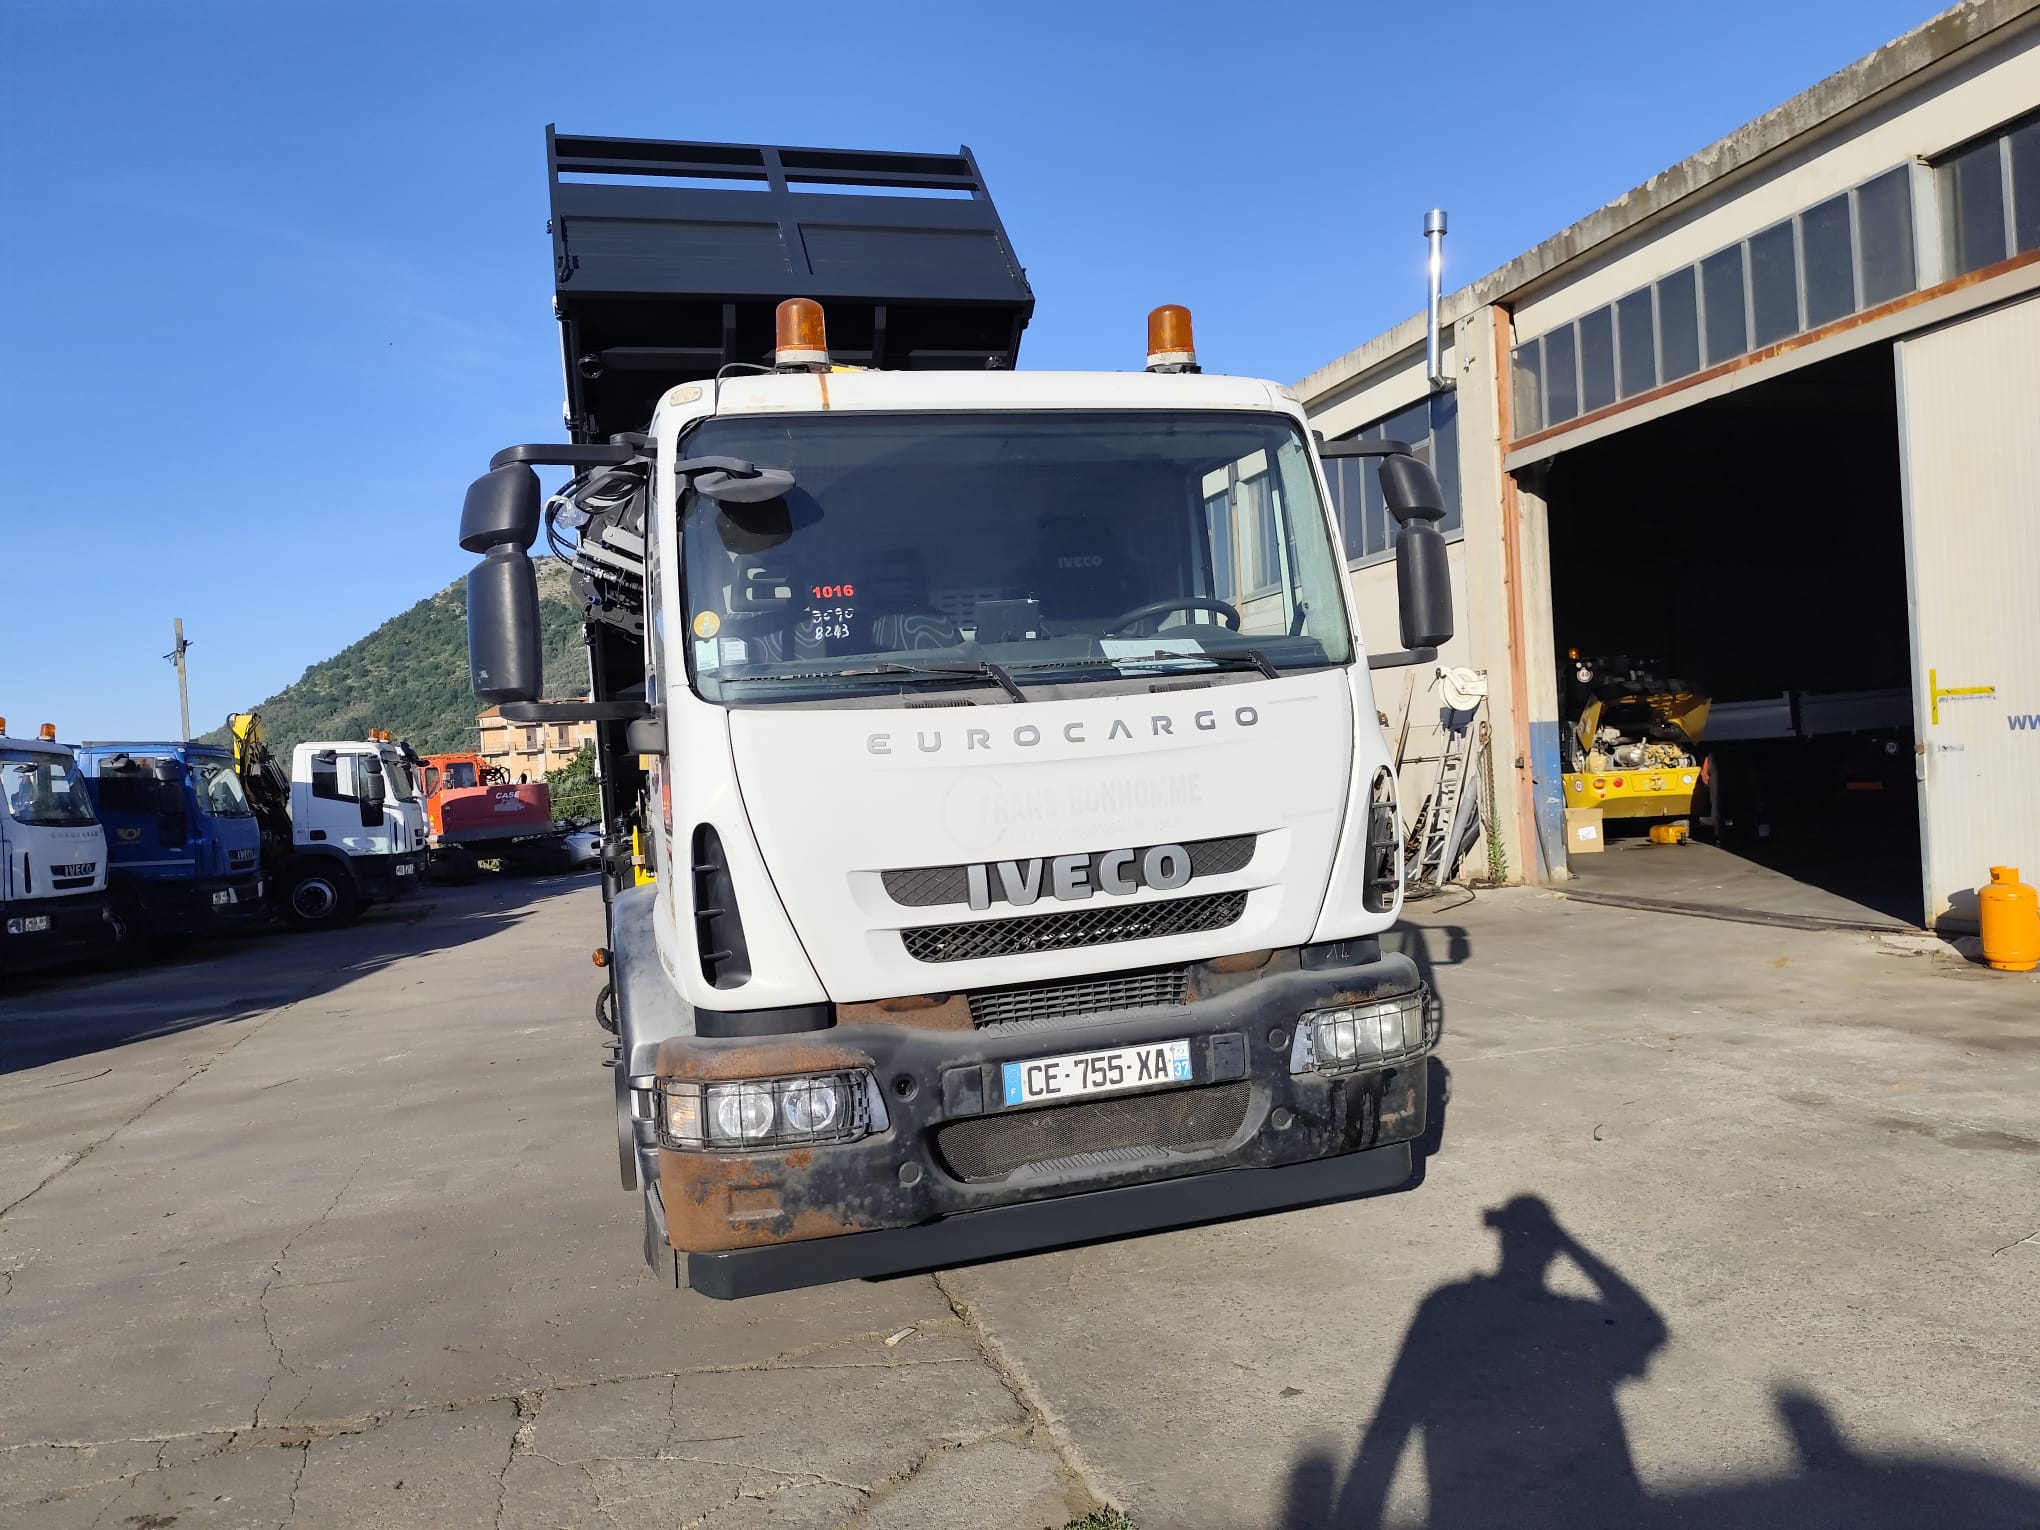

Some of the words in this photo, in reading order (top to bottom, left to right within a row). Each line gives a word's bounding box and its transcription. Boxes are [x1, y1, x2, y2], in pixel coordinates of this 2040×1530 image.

[1057, 555, 1103, 568] IVECO
[812, 584, 854, 599] 1016
[815, 623, 850, 640] 8243
[866, 706, 1259, 755] EUROCARGO
[495, 790, 520, 800] CASE
[64, 863, 92, 877] IVECO
[967, 844, 1192, 911] IVECO
[1010, 1088, 1017, 1097] F
[1027, 1048, 1169, 1097] CE-755-XA
[1174, 1060, 1190, 1077] 37
